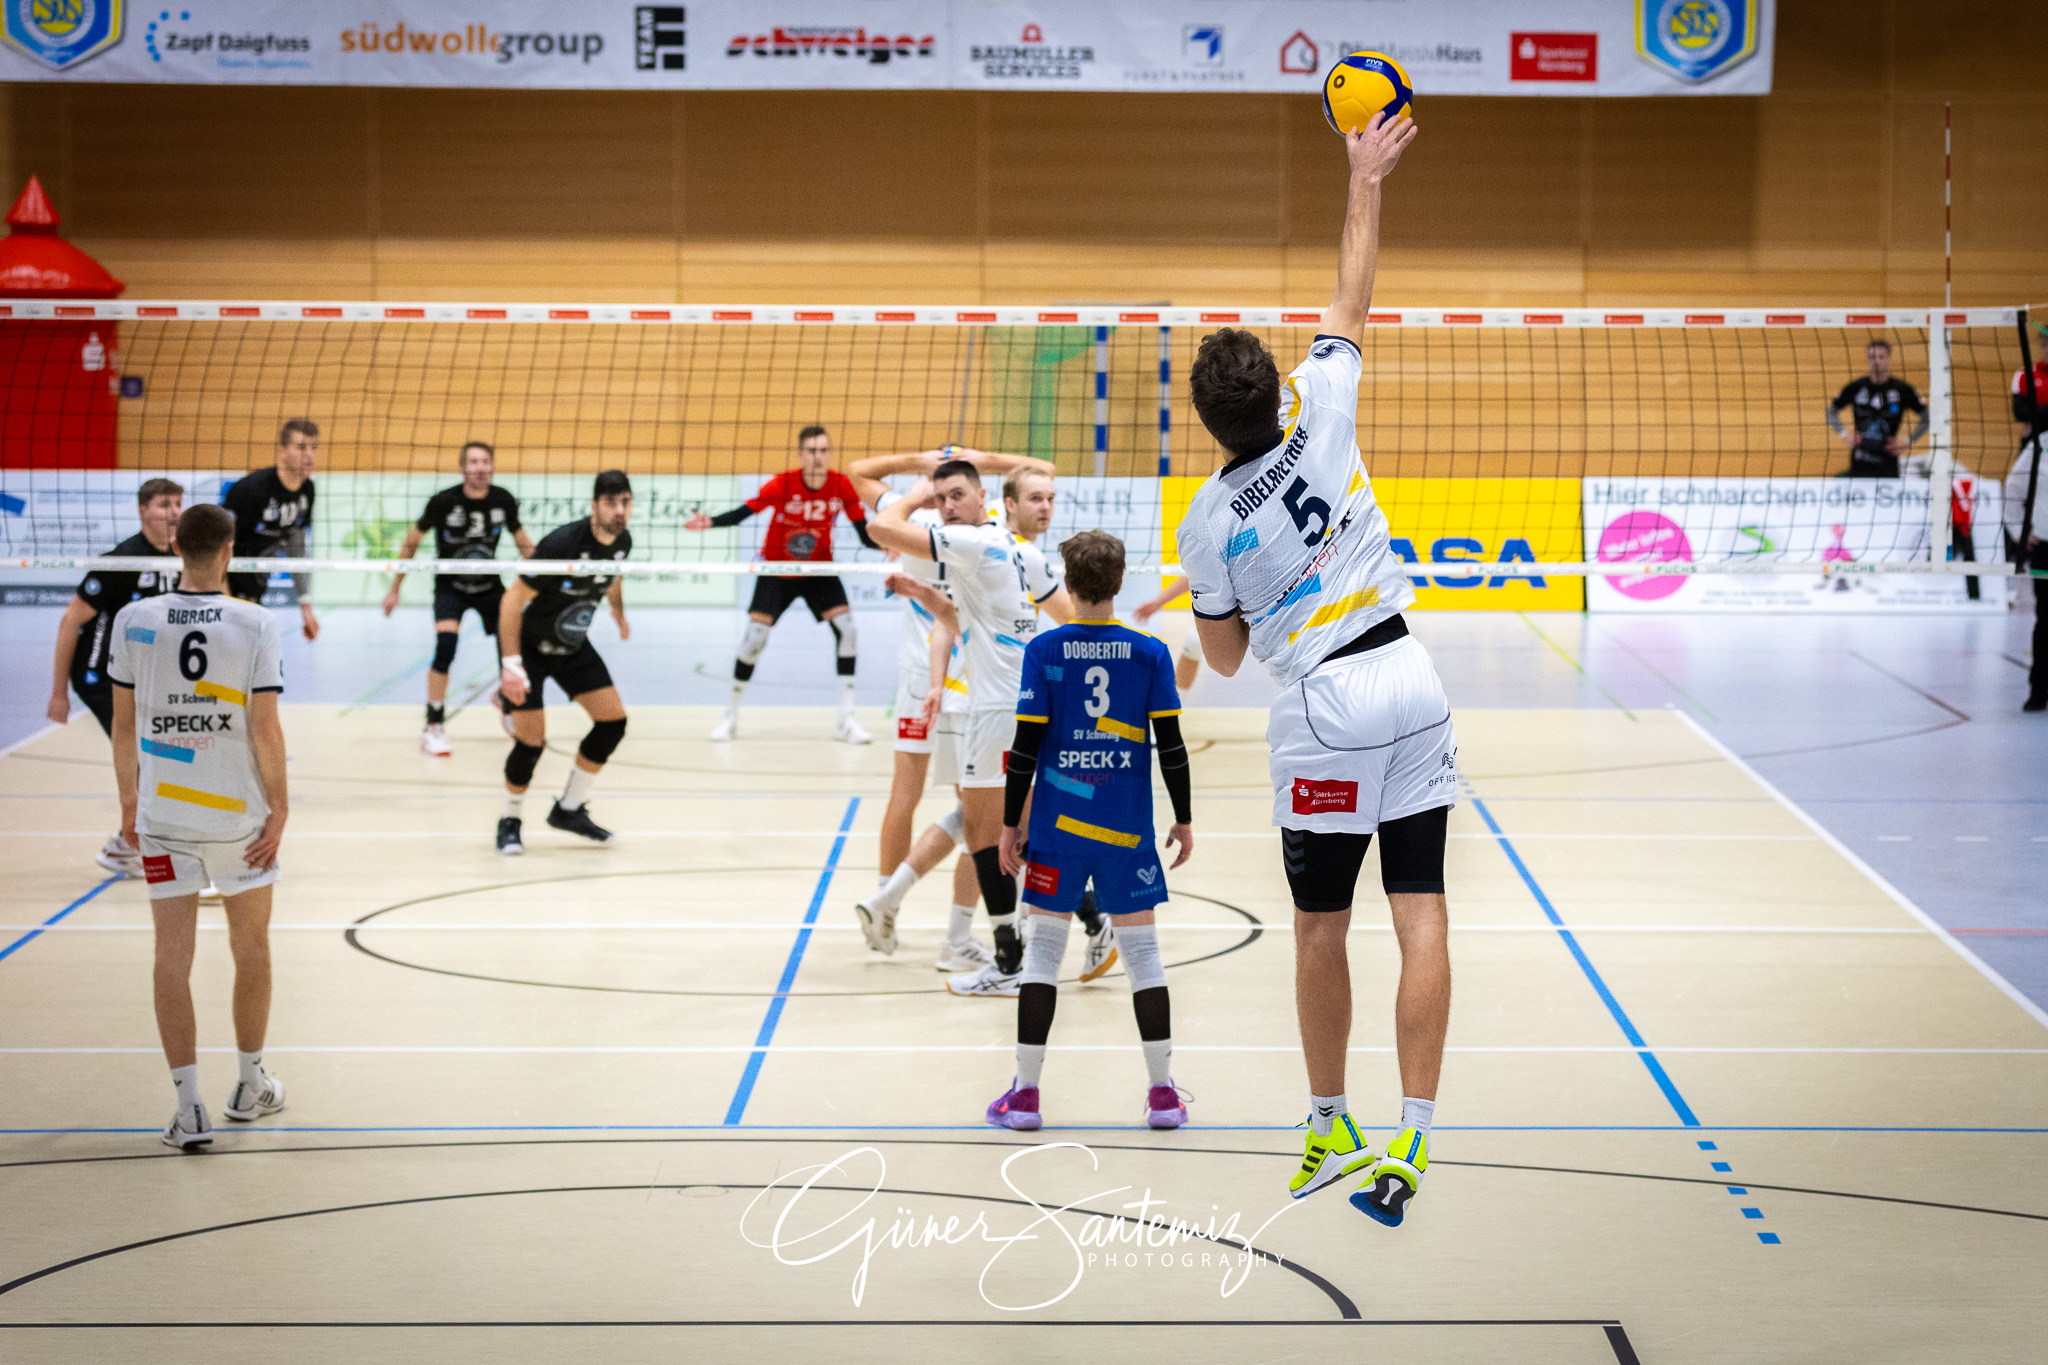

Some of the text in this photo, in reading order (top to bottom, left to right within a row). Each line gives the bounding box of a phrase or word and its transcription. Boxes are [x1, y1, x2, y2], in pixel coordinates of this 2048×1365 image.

[166, 33, 311, 53] Zapf Daigfuss
[1594, 482, 1649, 505] Hier
[1659, 482, 1817, 506] schnarchen
[1825, 485, 1868, 508] die
[803, 499, 828, 521] 12
[1281, 474, 1332, 548] 5
[1656, 565, 1698, 574] FUCHS
[1835, 565, 1876, 573] FUCHS
[167, 608, 223, 625] BIBRACK
[179, 630, 208, 681] 6
[1063, 641, 1131, 660] DOBBERTIN
[1084, 666, 1111, 718] 3
[152, 715, 214, 734] SPECK
[1073, 729, 1120, 742] SV Schwaig
[1058, 751, 1115, 768] SPECK
[1312, 790, 1349, 799] Sparkasse
